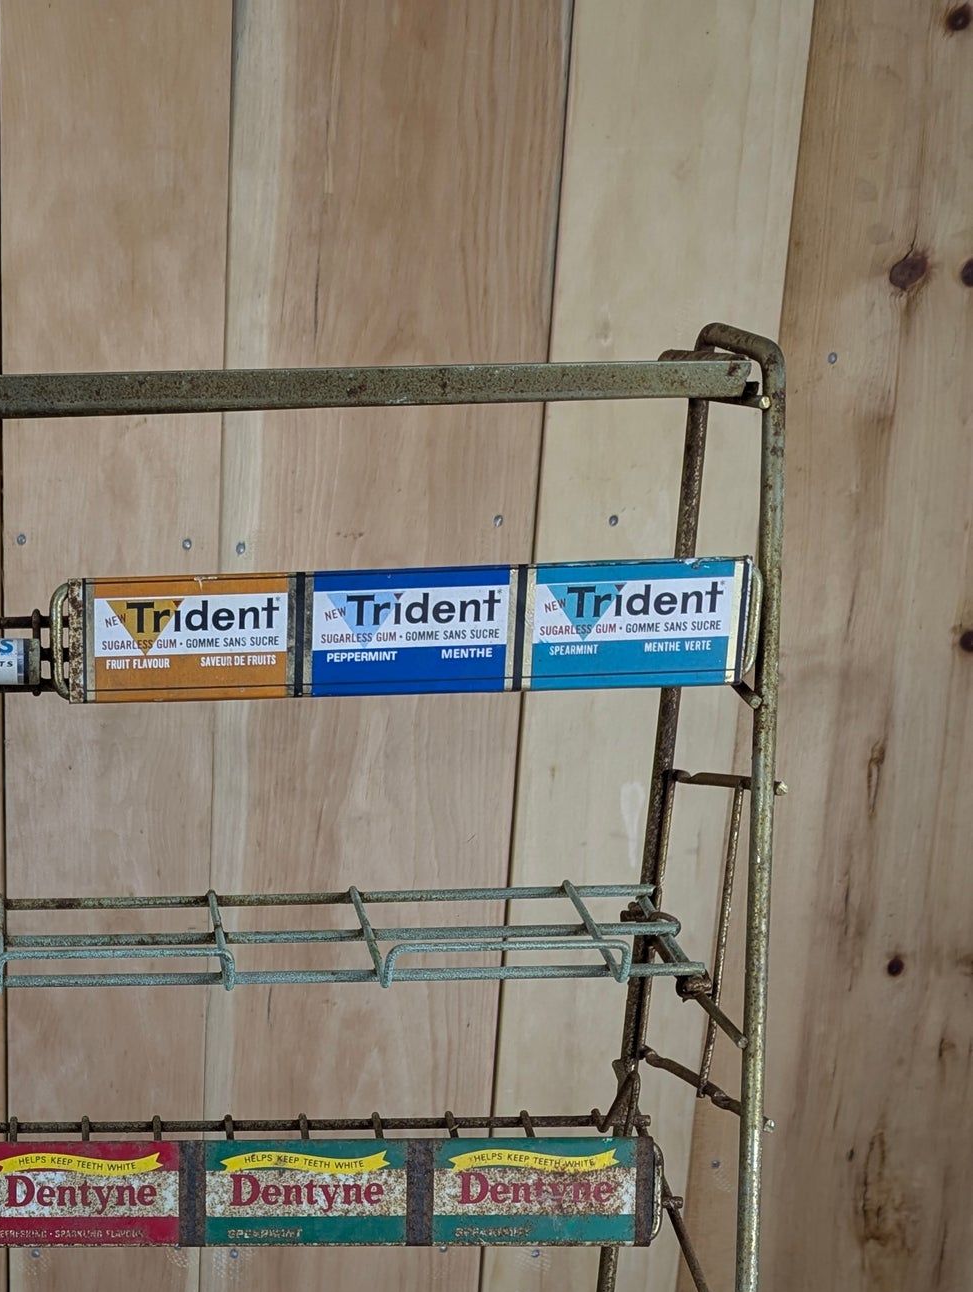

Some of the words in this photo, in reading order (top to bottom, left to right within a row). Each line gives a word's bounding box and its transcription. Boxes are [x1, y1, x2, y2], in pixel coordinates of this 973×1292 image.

[346, 589, 502, 627] Trident
[544, 598, 567, 614] NEW
[566, 581, 725, 619] Trident
[104, 613, 127, 628] NEW
[126, 597, 280, 633] Trident
[324, 607, 347, 622] NEW
[320, 632, 373, 644] SUGARLESS
[376, 631, 397, 642] GUM
[405, 630, 440, 642] GOMME
[443, 629, 467, 640] SANS
[470, 628, 500, 640] SUCRE
[539, 624, 592, 636] SUGARLESS
[595, 623, 617, 635] GUM
[625, 622, 661, 634] GOMME
[663, 621, 688, 633] SANS
[691, 620, 722, 632] SUCRE
[102, 638, 154, 651] SUGARLESS
[156, 638, 177, 650] GUM
[186, 637, 220, 649] GOMME
[223, 636, 247, 648] SANS
[250, 635, 280, 647] SUCRE
[548, 644, 599, 656] SPEARMINT
[644, 641, 682, 653] MENTHE
[684, 640, 712, 652] VERTE
[200, 654, 233, 667] SAVEUR
[234, 654, 248, 667] DE
[249, 653, 277, 666] FRUITS
[326, 651, 398, 663] PEPPERMINT
[441, 648, 493, 660] MENTHE
[105, 656, 130, 670] FRUIT
[132, 656, 171, 669] FLAVOUR
[18, 1156, 47, 1166] HELPS
[50, 1157, 73, 1166] KEEP
[77, 1160, 103, 1171] TEETH
[107, 1162, 136, 1172] WHITE
[244, 1154, 273, 1164] HELPS
[277, 1155, 300, 1164] KEEP
[303, 1158, 330, 1169] TEETH
[334, 1159, 364, 1169] WHITE
[473, 1153, 503, 1163] HELPS
[507, 1153, 530, 1163] KEEP
[533, 1156, 561, 1167] TEETH
[566, 1158, 596, 1167] WHITE
[4, 1175, 157, 1215] Dentyne
[229, 1174, 384, 1213] Dentyne
[458, 1172, 615, 1211] Dentyne
